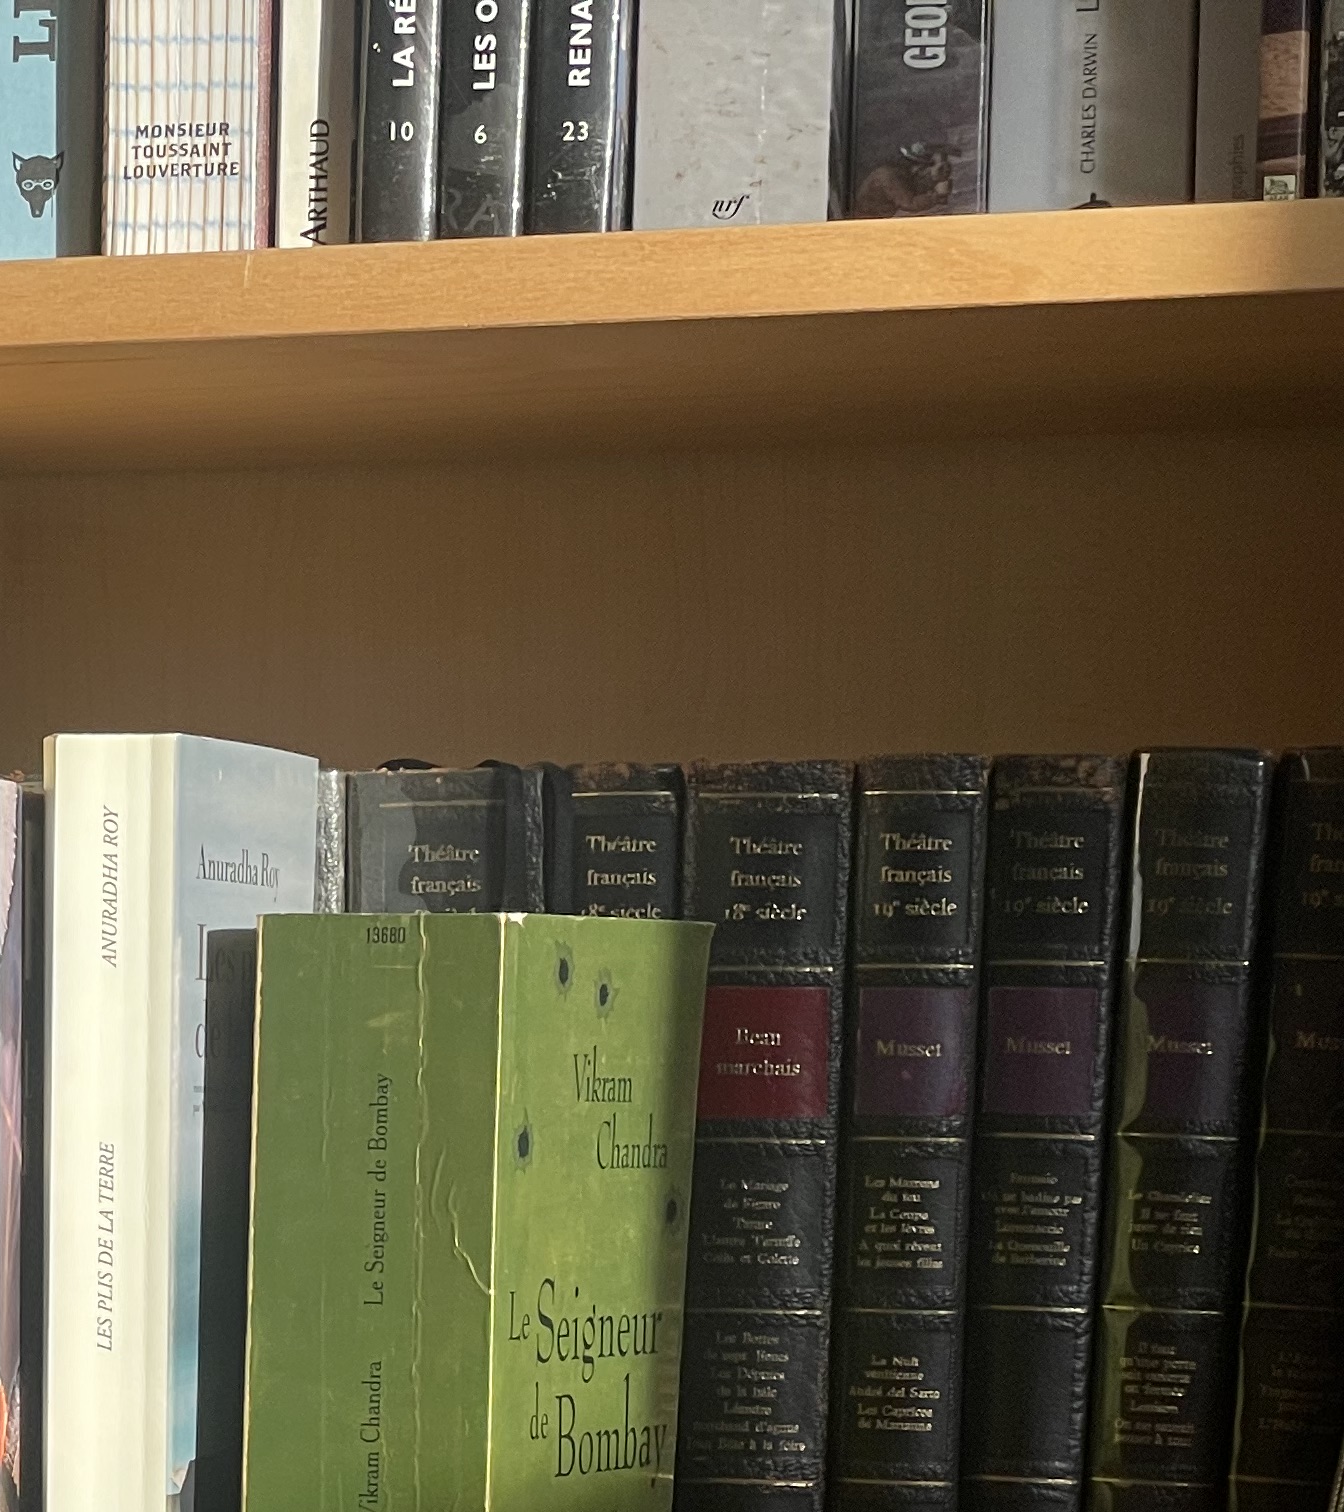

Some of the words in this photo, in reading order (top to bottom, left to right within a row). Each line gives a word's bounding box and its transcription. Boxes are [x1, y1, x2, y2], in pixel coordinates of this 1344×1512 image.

[135, 122, 230, 138] MONSIEUR
[562, 121, 589, 141] 23
[131, 143, 232, 158] TOUSSAINT
[124, 162, 240, 179] LOUVERTURE
[300, 118, 330, 245] ARTHAUD
[102, 806, 120, 840] ROY
[586, 835, 657, 853] Théâtre
[730, 836, 802, 856] Théâtre
[880, 833, 953, 851] Théâtre
[408, 846, 479, 863] Théâtre
[587, 869, 657, 887] français
[880, 865, 952, 885] français
[411, 877, 482, 895] français
[101, 842, 120, 968] ANURADHA
[876, 1039, 941, 1057] Musset
[573, 1045, 632, 1103] Vikram
[597, 1114, 667, 1170] Chandra
[530, 1382, 548, 1440] de
[554, 1374, 668, 1488] Bombay
